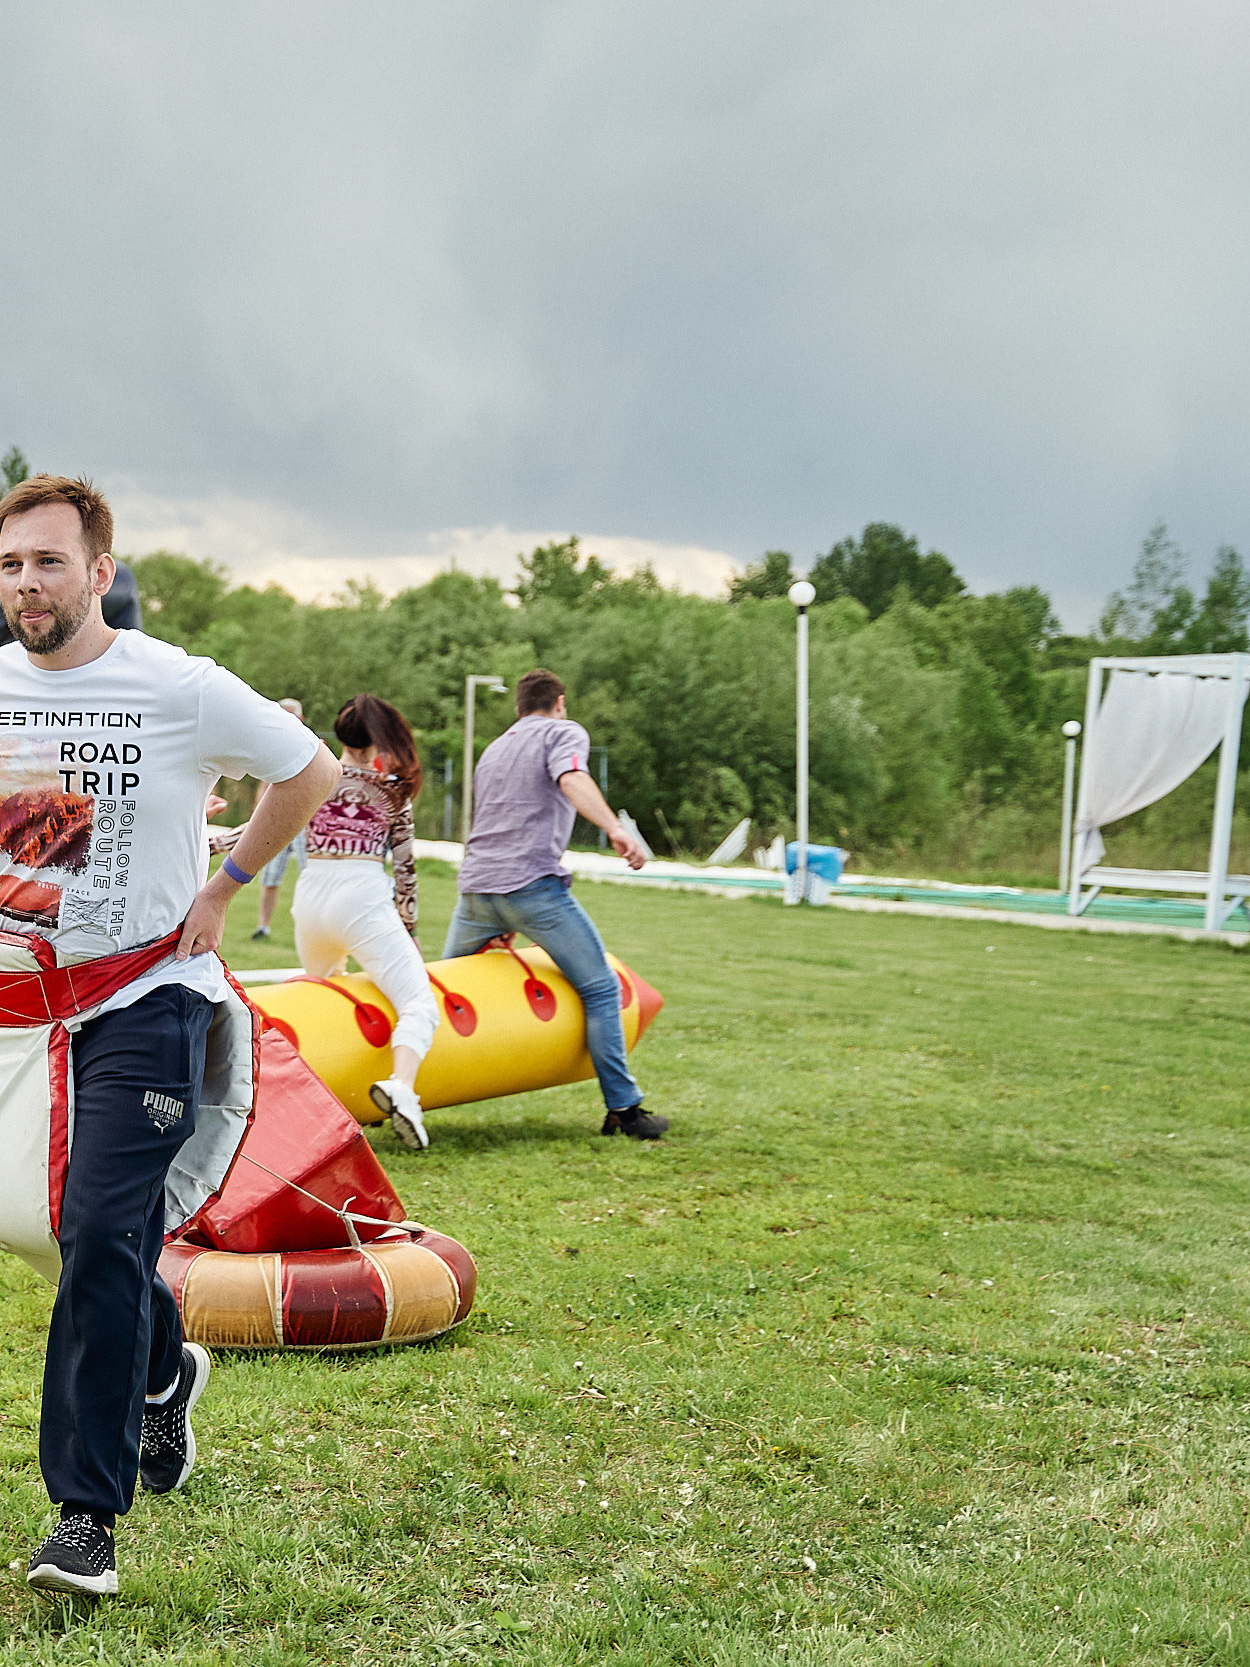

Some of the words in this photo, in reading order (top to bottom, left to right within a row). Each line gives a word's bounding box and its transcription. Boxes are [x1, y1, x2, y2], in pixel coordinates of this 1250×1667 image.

[60, 741, 142, 765] ROAD
[58, 769, 140, 796] TRIP
[93, 799, 117, 889] ROUTE
[115, 800, 136, 887] FOLLOW
[66, 887, 91, 897] SPACE
[109, 897, 126, 937] THE
[142, 1090, 185, 1119] PUMA
[147, 1107, 178, 1123] ORIGINAL
